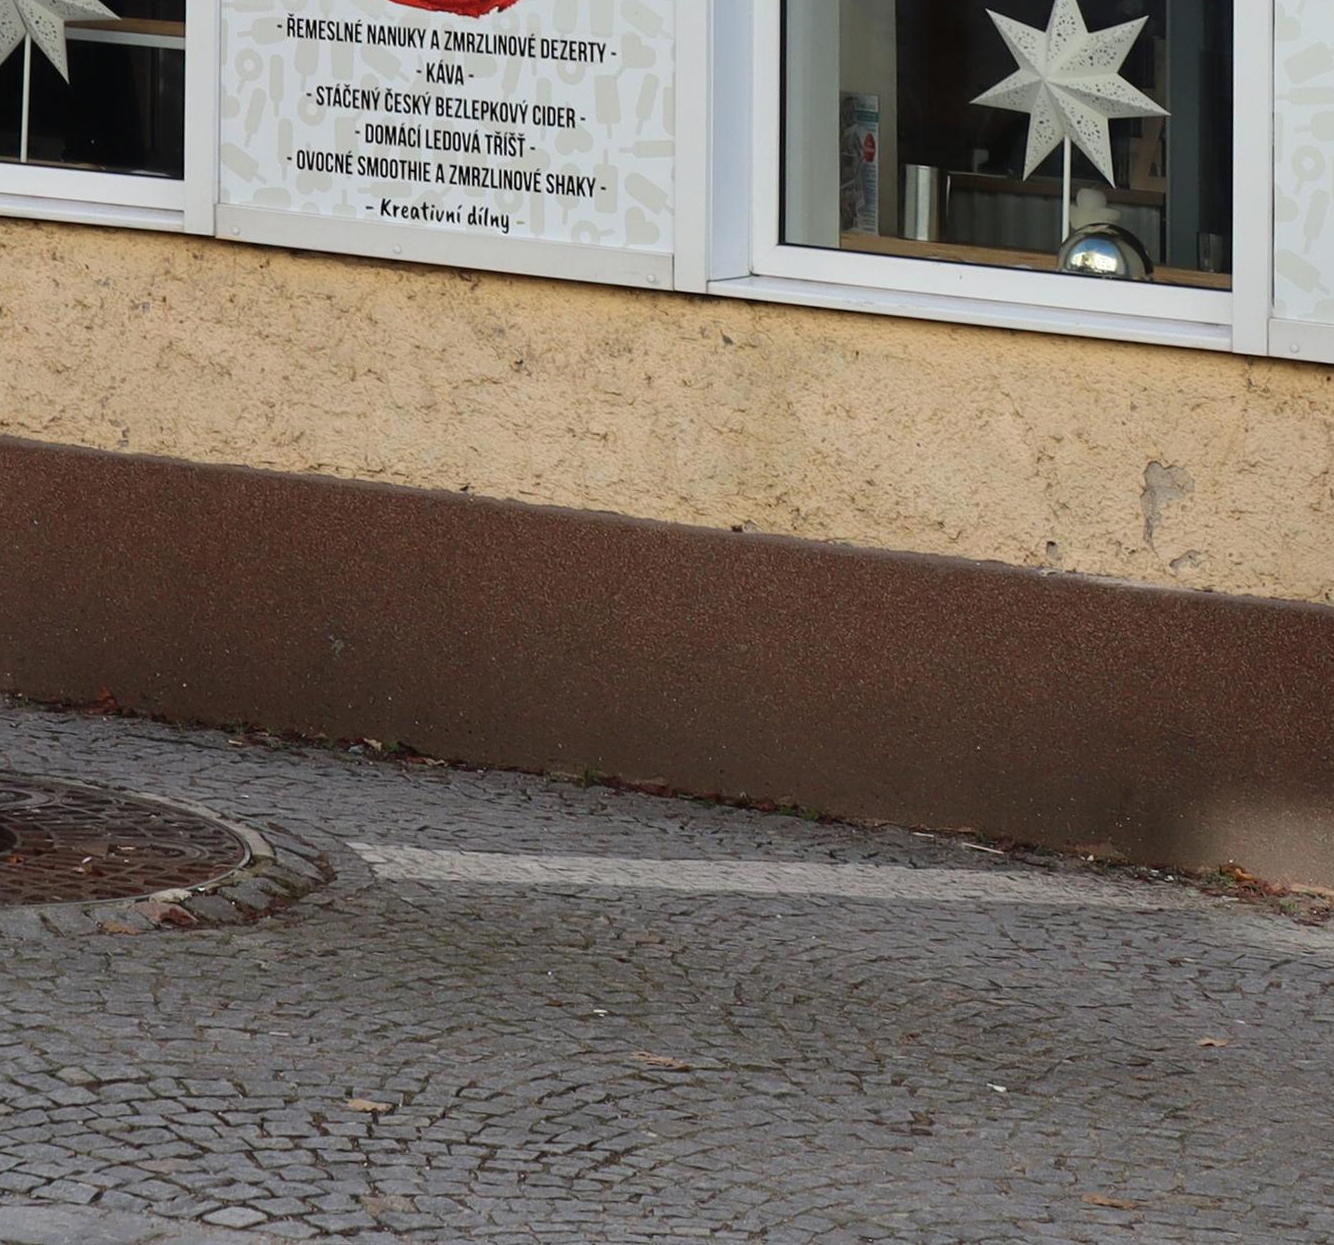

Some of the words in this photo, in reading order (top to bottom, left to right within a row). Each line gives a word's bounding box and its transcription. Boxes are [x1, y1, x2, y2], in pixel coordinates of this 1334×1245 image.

[286, 13, 363, 44] ŘEMESLNÉ
[367, 24, 426, 49] NANUKY
[430, 29, 440, 50] A
[443, 30, 536, 59] ZMRZLINOVÉ
[540, 38, 606, 63] DEZERTY
[426, 62, 464, 86] KÁVA
[316, 84, 381, 111] STÁČENÝ
[384, 88, 432, 116] ČESKÝ
[435, 96, 528, 124] BEZLEPKOVÝ
[532, 104, 576, 129] CIDER
[365, 123, 421, 148] DOMÁCÍ
[425, 129, 481, 154] LEDOVÁ
[484, 131, 526, 158] TŘÍŠŤ
[296, 149, 353, 175] OVOCNÉ
[357, 155, 431, 183] SMOOTHIE
[435, 163, 445, 184] A
[449, 164, 542, 193] ZMRZLINOVÉ
[546, 173, 596, 198] SHAKY
[380, 198, 462, 224] Kreativní
[467, 205, 510, 234] dílny
